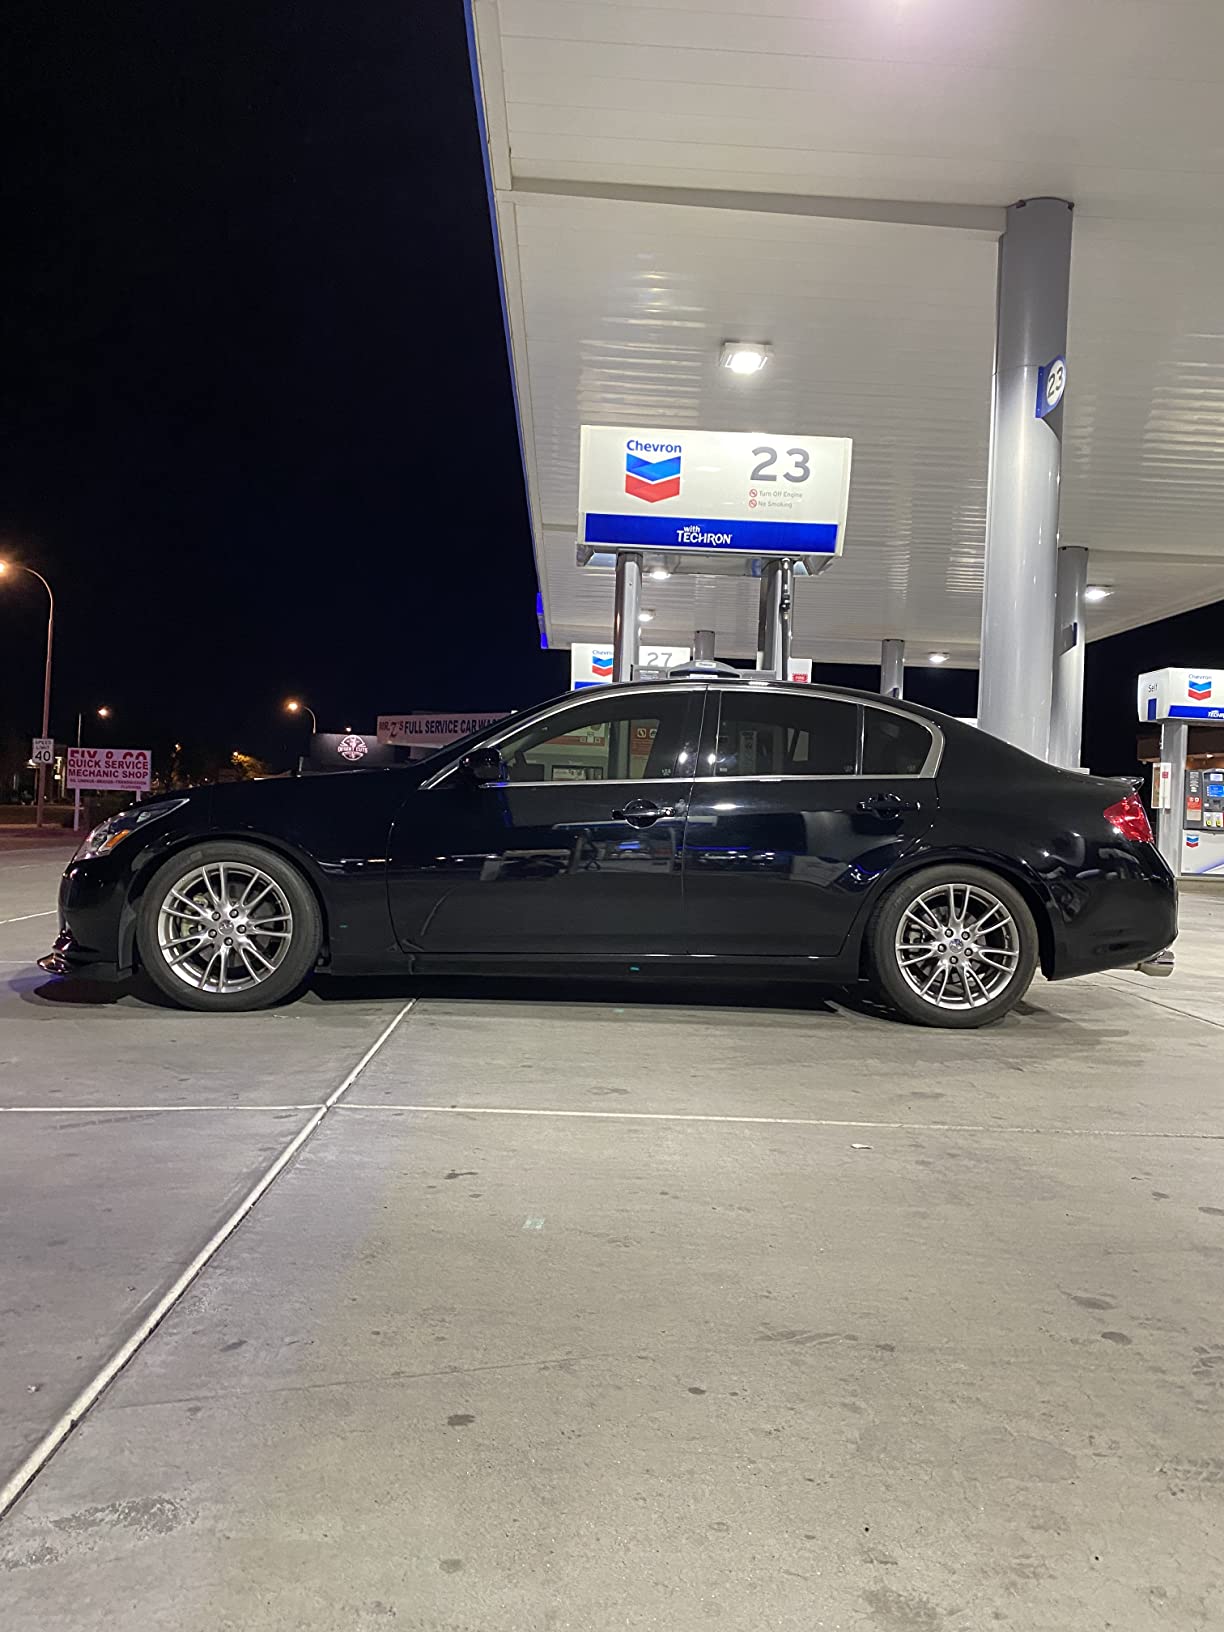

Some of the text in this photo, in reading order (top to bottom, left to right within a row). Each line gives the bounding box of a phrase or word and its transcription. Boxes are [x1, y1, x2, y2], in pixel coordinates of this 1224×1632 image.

[1047, 366, 1063, 399] 23
[626, 439, 682, 454] Chevron
[750, 446, 811, 483] 23
[783, 490, 803, 499] Engine
[767, 501, 793, 509] Smoking
[683, 524, 701, 533] with
[676, 530, 731, 546] TECHRON
[647, 652, 673, 667] 27
[404, 720, 423, 735] FULL
[424, 719, 459, 734] SERVICE
[460, 719, 477, 734] CAR
[35, 751, 51, 762] 40
[68, 759, 149, 771] QUICK SERVICE
[68, 769, 149, 779] MECHANIC SHOP
